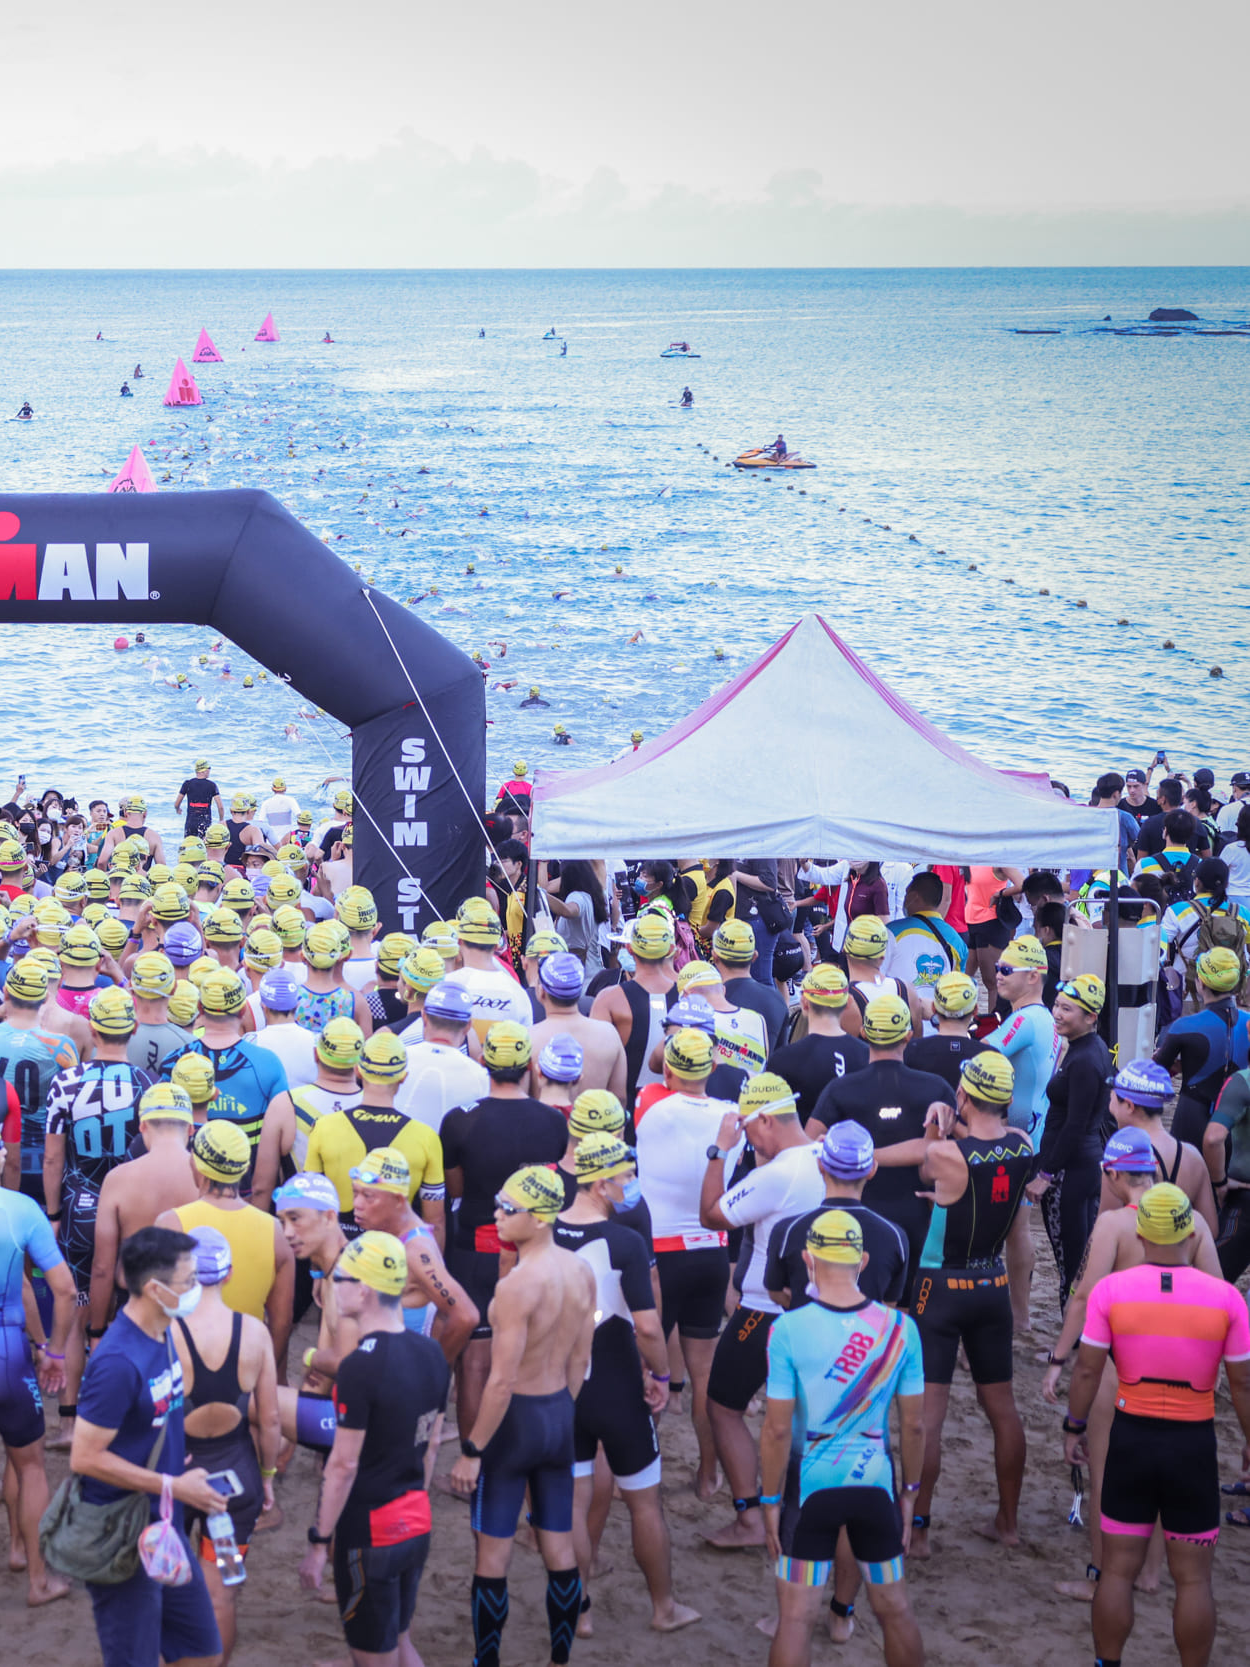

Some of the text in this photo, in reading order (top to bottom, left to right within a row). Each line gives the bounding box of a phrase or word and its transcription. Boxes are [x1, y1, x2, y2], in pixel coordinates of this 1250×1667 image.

[393, 738, 432, 943] SWIM ST
[718, 1036, 765, 1064] IRONMAN
[72, 1064, 134, 1121] ZO
[73, 1107, 134, 1159] OT
[518, 1180, 540, 1200] 70.3
[916, 1278, 932, 1314] core
[824, 1332, 875, 1385] TRBB
